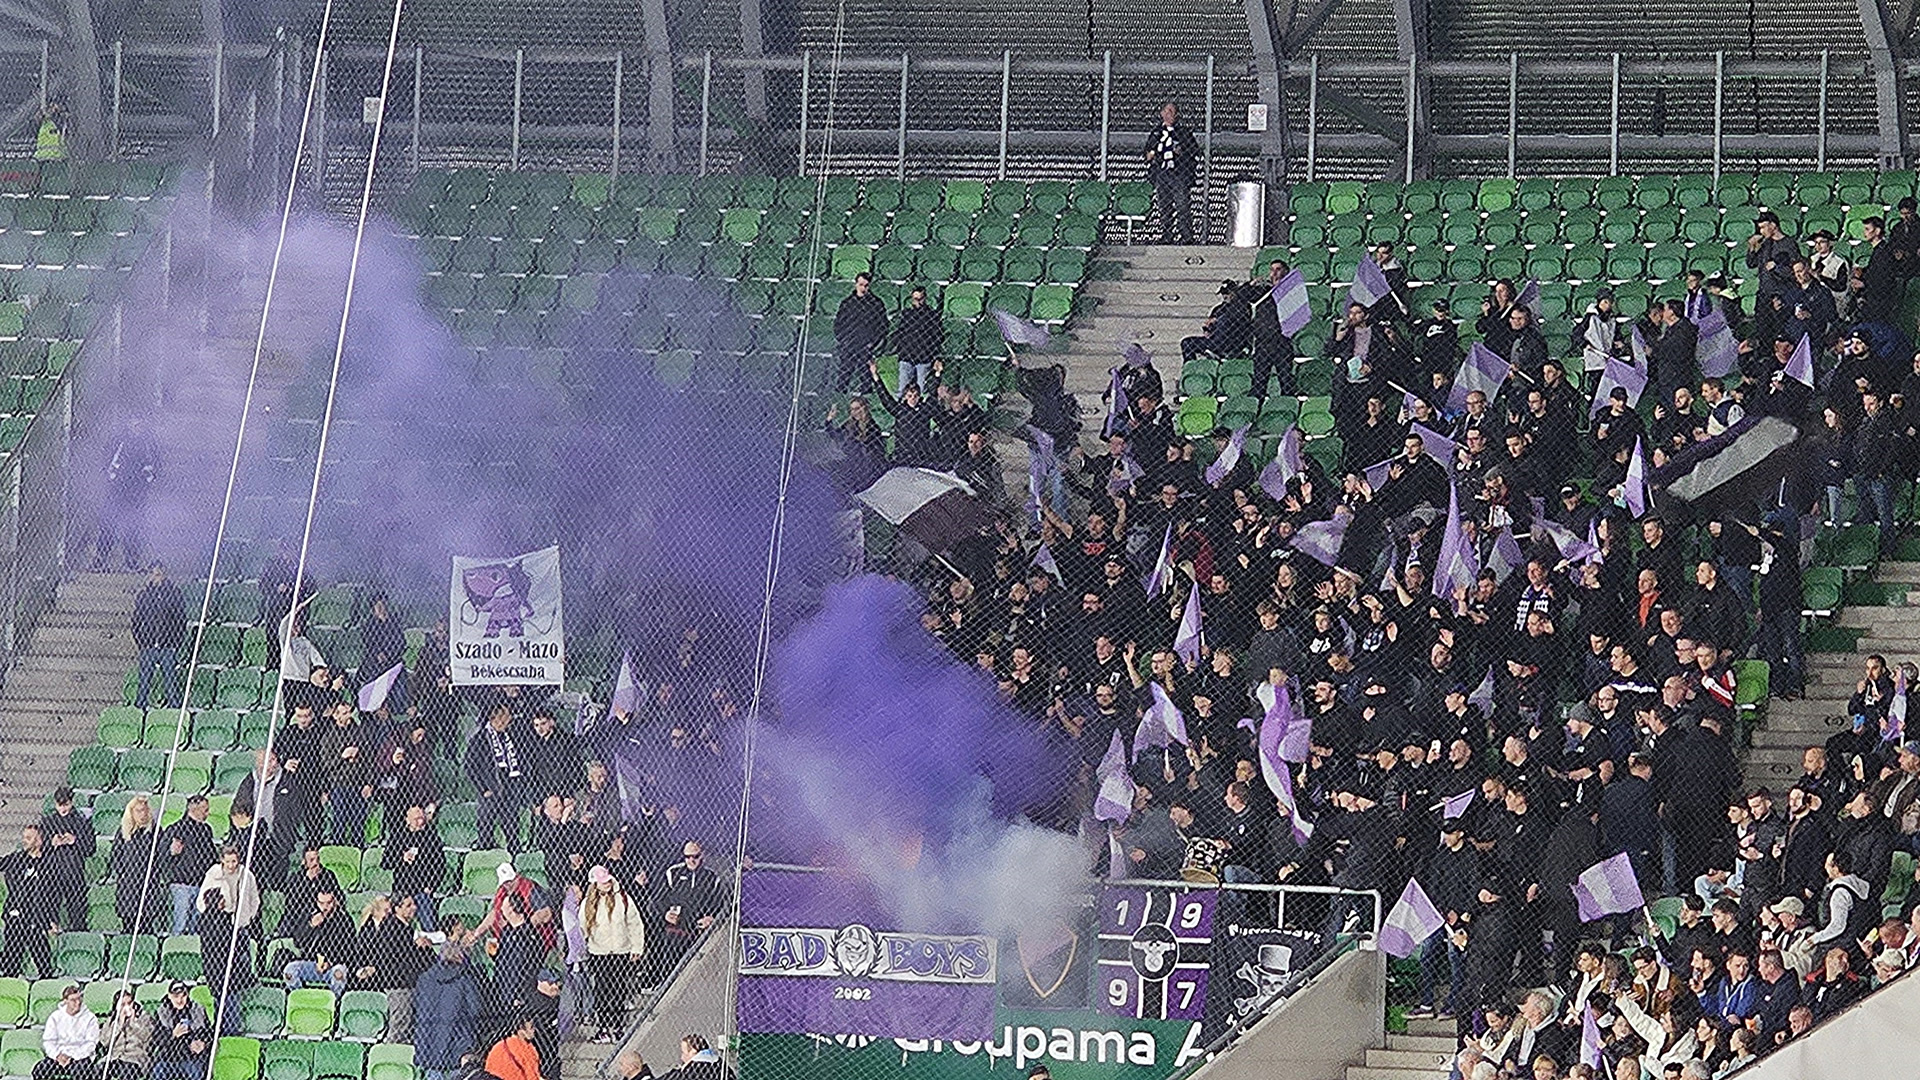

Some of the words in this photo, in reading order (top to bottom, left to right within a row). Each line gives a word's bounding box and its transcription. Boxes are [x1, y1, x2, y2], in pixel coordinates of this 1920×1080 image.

[1115, 899, 1130, 926] 1
[1180, 902, 1203, 929] 9
[739, 931, 829, 970] BAD
[882, 936, 992, 979] BOYS
[1108, 979, 1128, 1007] 9
[1176, 981, 1196, 1010] 7
